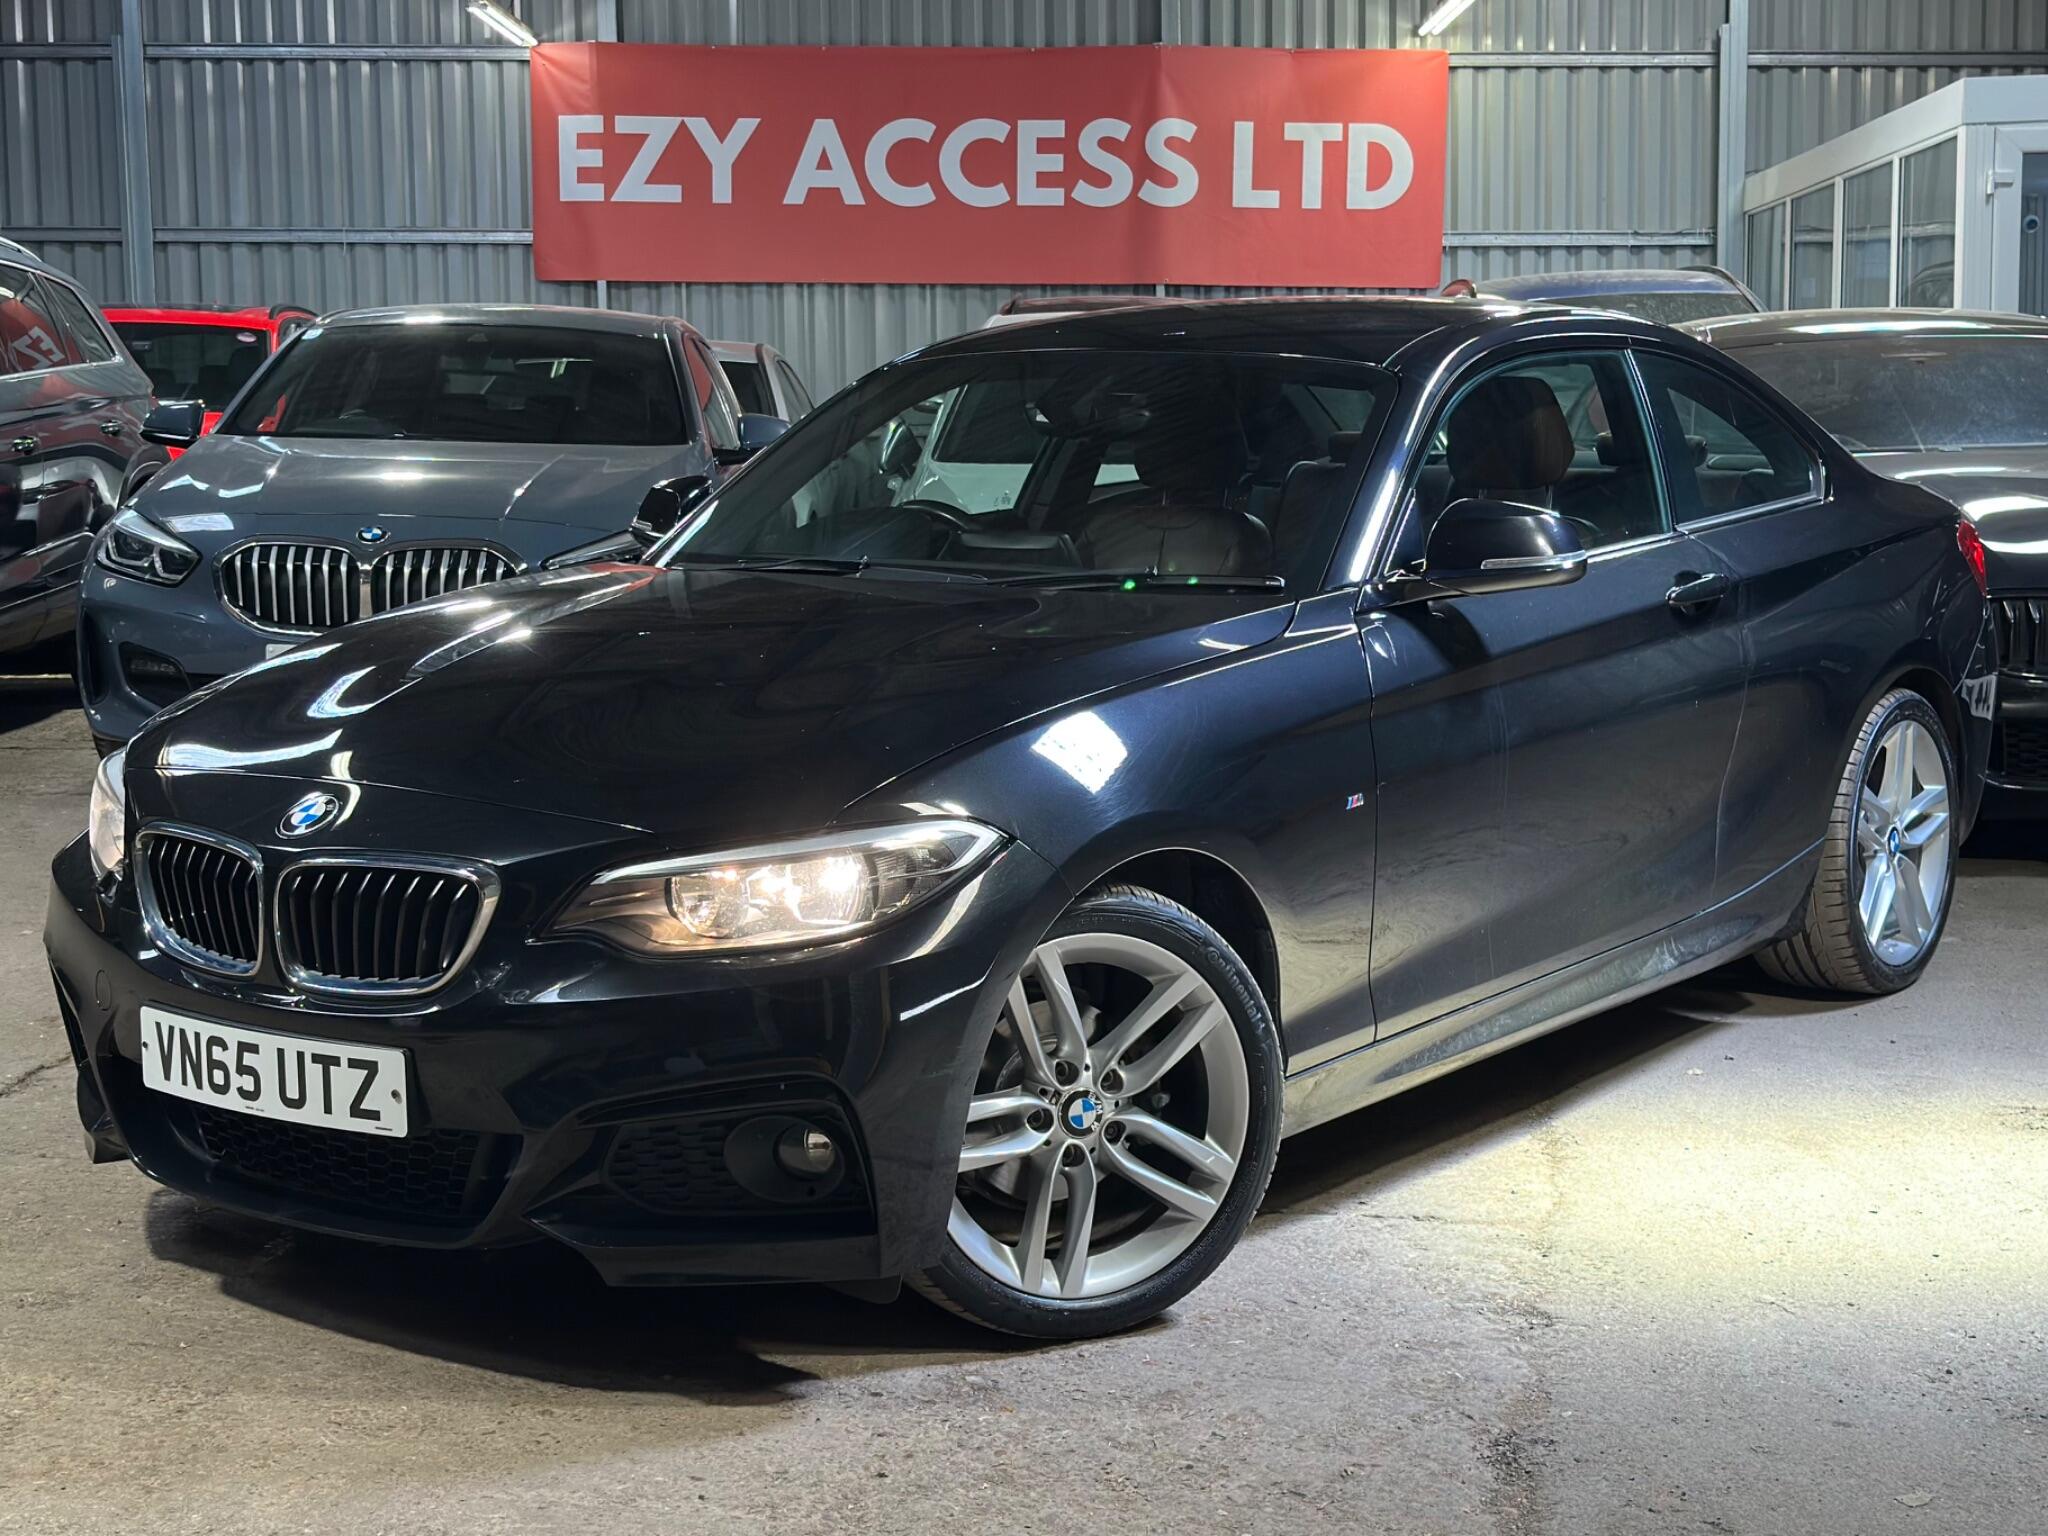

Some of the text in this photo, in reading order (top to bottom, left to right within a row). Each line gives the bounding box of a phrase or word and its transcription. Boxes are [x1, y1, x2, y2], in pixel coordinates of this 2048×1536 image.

[557, 114, 1415, 210] EZY ACCESS LTD
[154, 1020, 382, 1122] VN65 UTZ
